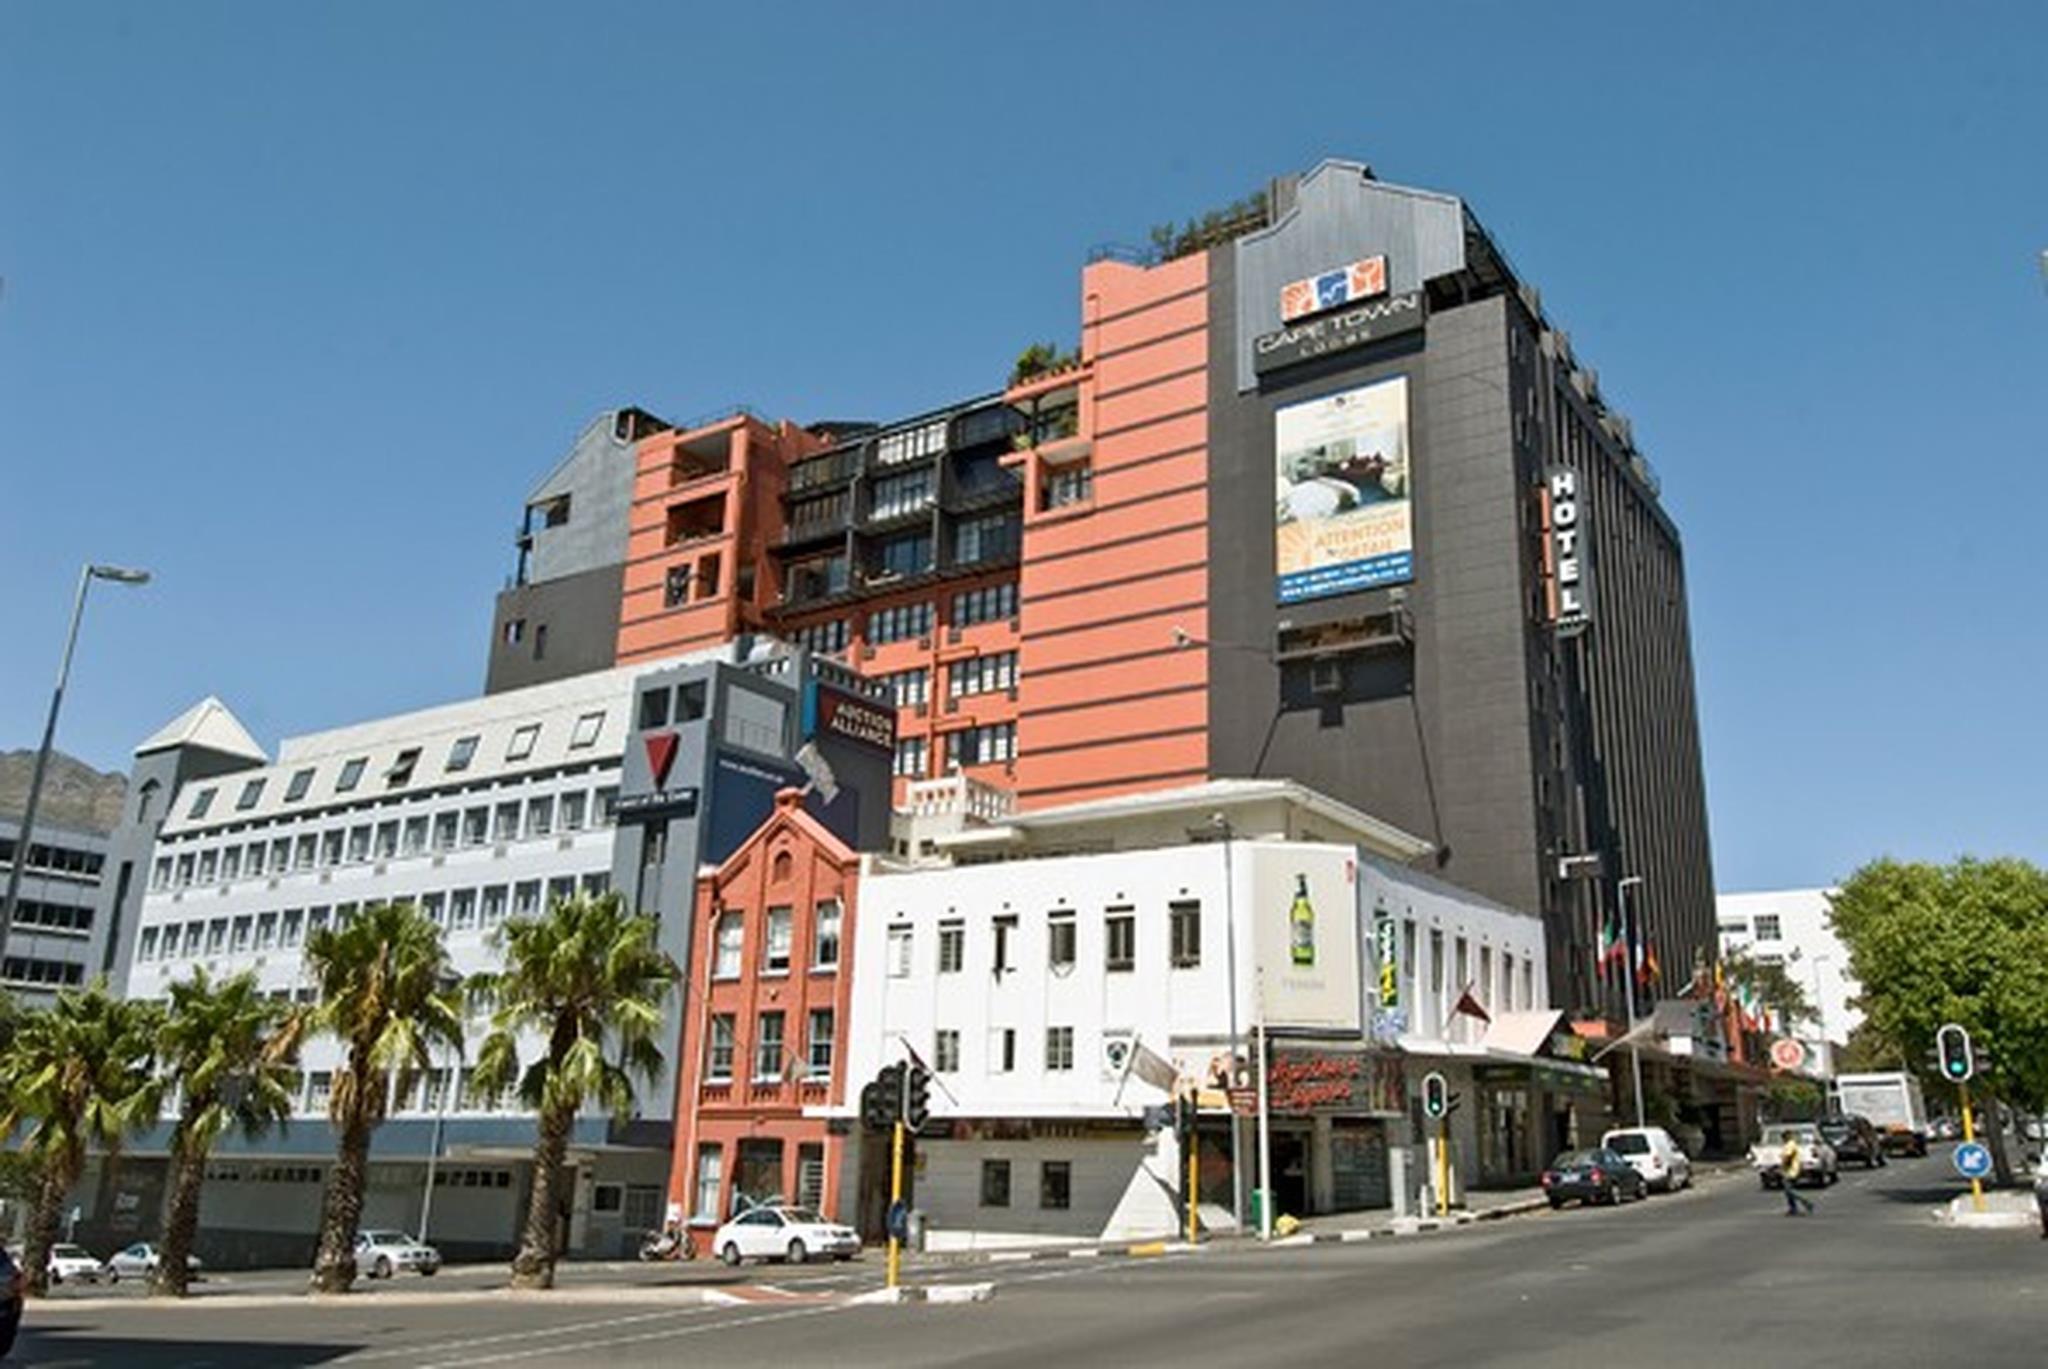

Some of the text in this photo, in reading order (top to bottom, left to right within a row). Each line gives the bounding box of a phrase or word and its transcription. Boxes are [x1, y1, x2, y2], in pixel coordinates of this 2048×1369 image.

[1257, 293, 1417, 354] CAPE TOWN
[1552, 472, 1581, 613] HOTEL
[830, 716, 892, 748] ALLIANCE
[836, 702, 892, 731] AUCTION
